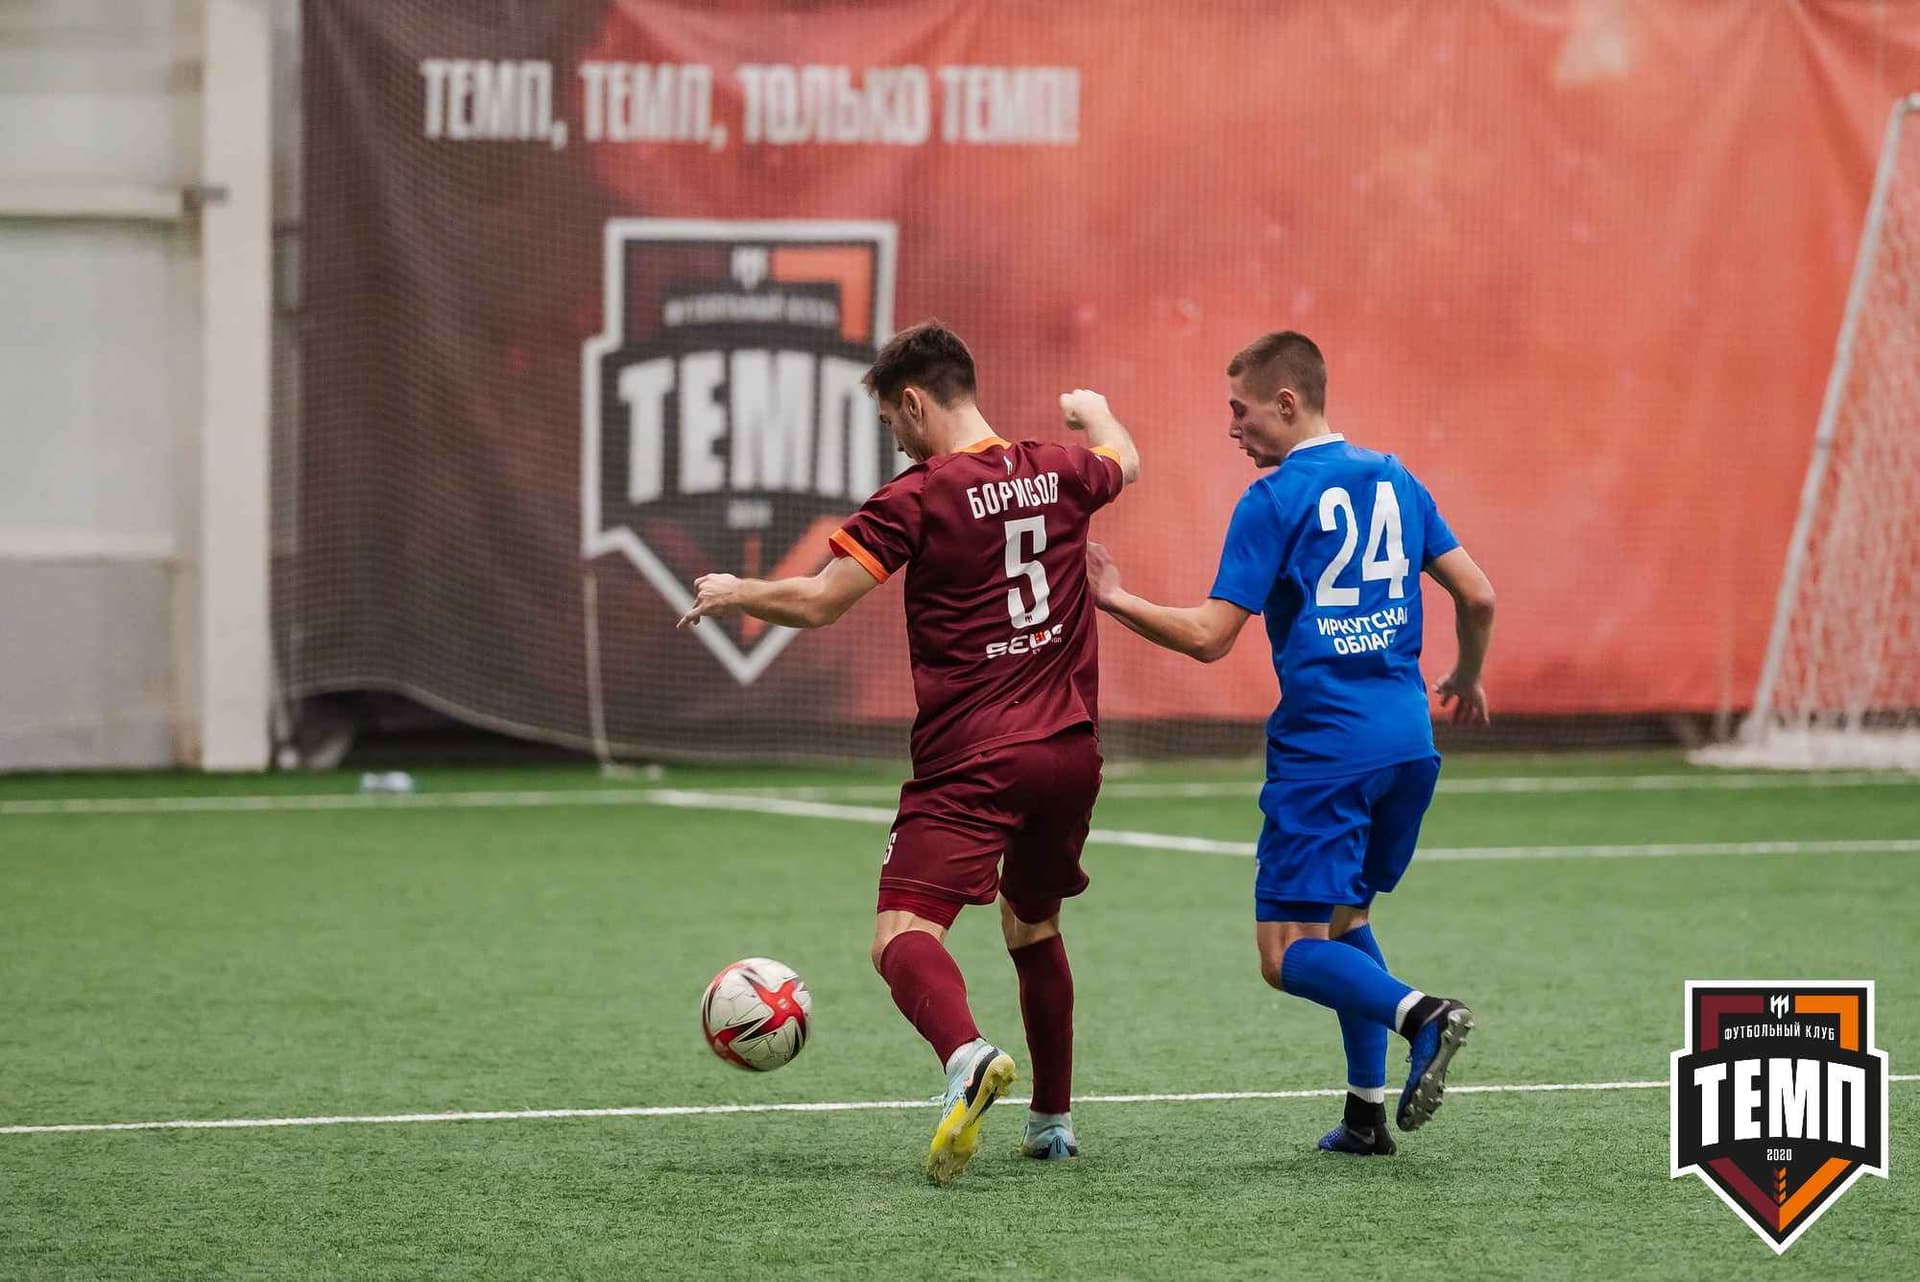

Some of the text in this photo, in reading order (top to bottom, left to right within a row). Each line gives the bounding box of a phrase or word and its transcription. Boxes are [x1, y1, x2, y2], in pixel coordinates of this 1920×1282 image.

[420, 59, 567, 150] ТЕМП,
[579, 60, 727, 150] ТЕМП,
[735, 65, 932, 146] ТОЛЬКО
[617, 350, 880, 506] ТЕМП
[966, 472, 1059, 519] БОРИСОВ
[1315, 481, 1409, 607] 24
[1004, 514, 1049, 629] 5
